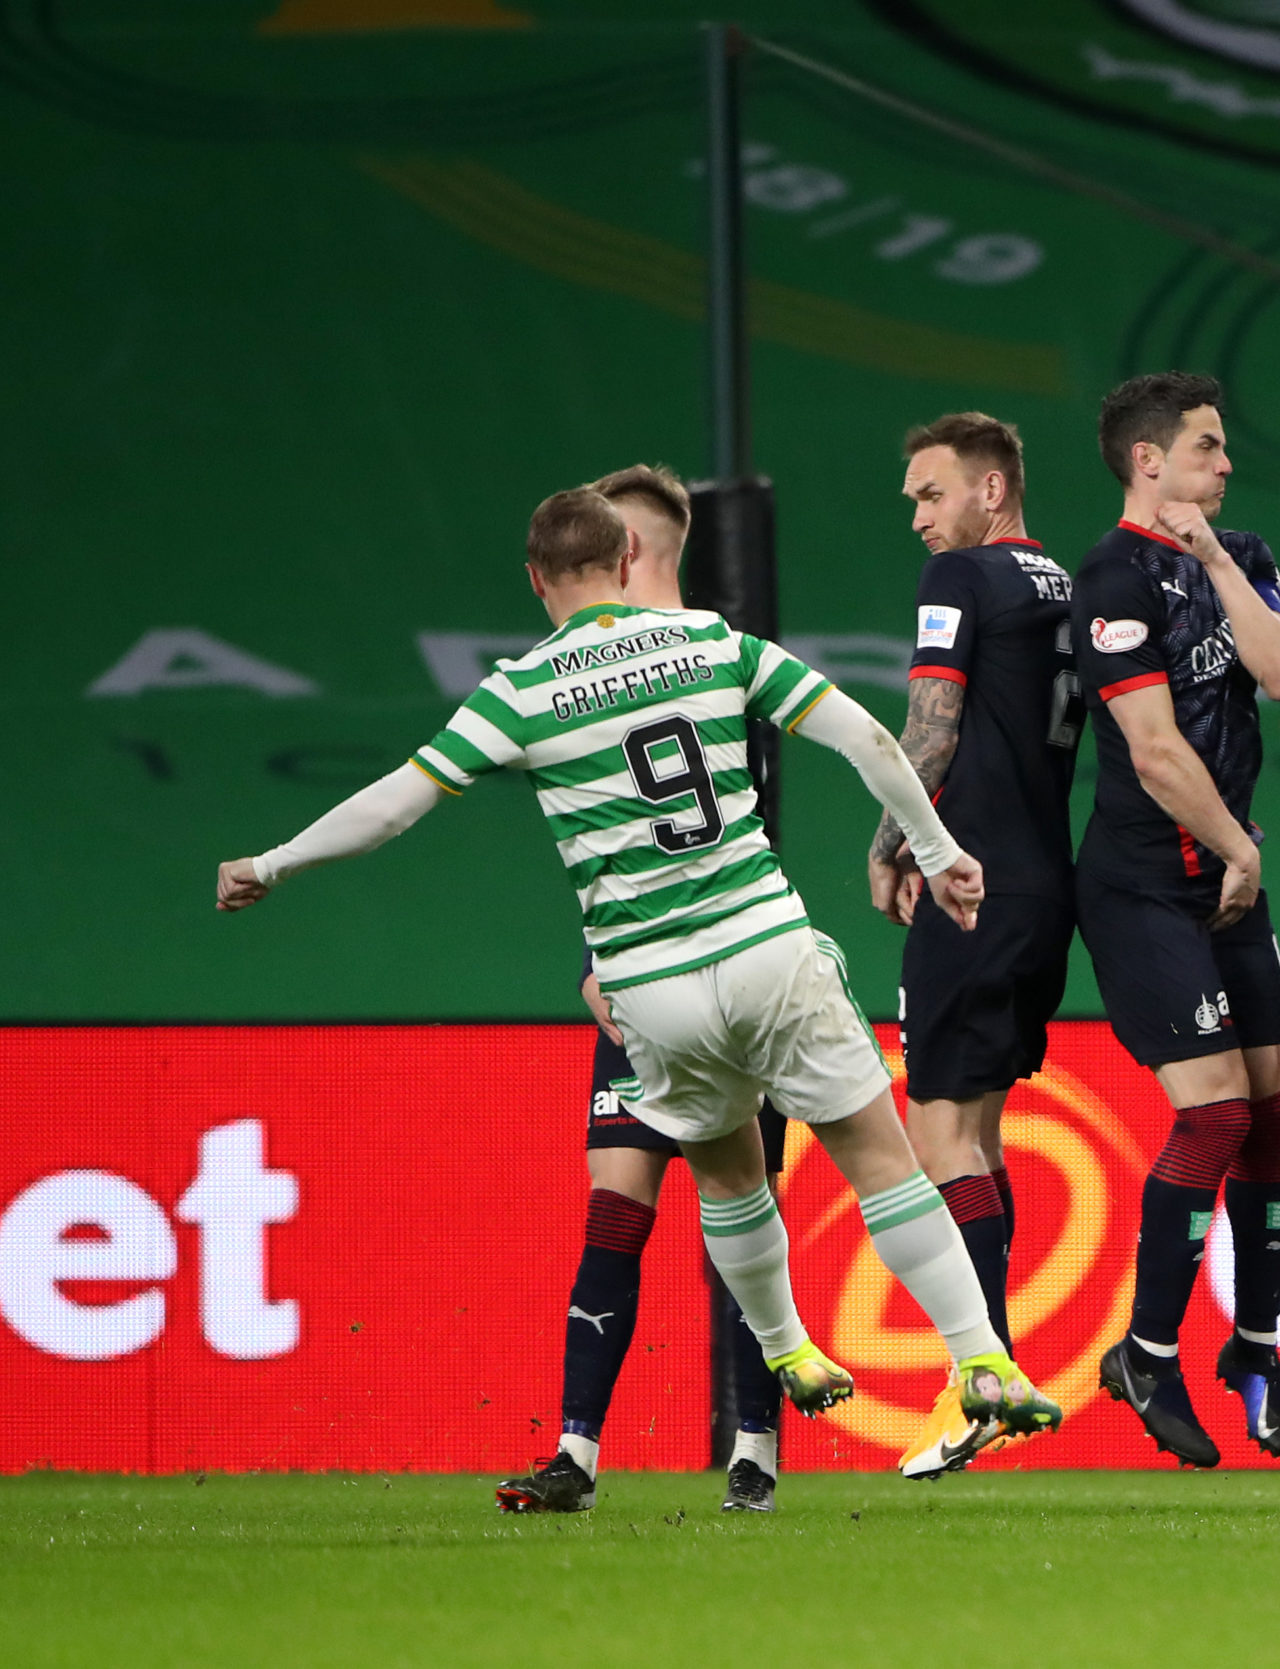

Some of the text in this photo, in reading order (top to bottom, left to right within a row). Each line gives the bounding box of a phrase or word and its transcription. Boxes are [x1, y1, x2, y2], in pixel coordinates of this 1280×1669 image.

[552, 628, 688, 676] MAGNERS
[1104, 631, 1138, 643] LEAGUE
[551, 654, 714, 721] GRIFFITHS
[621, 712, 725, 856] 9
